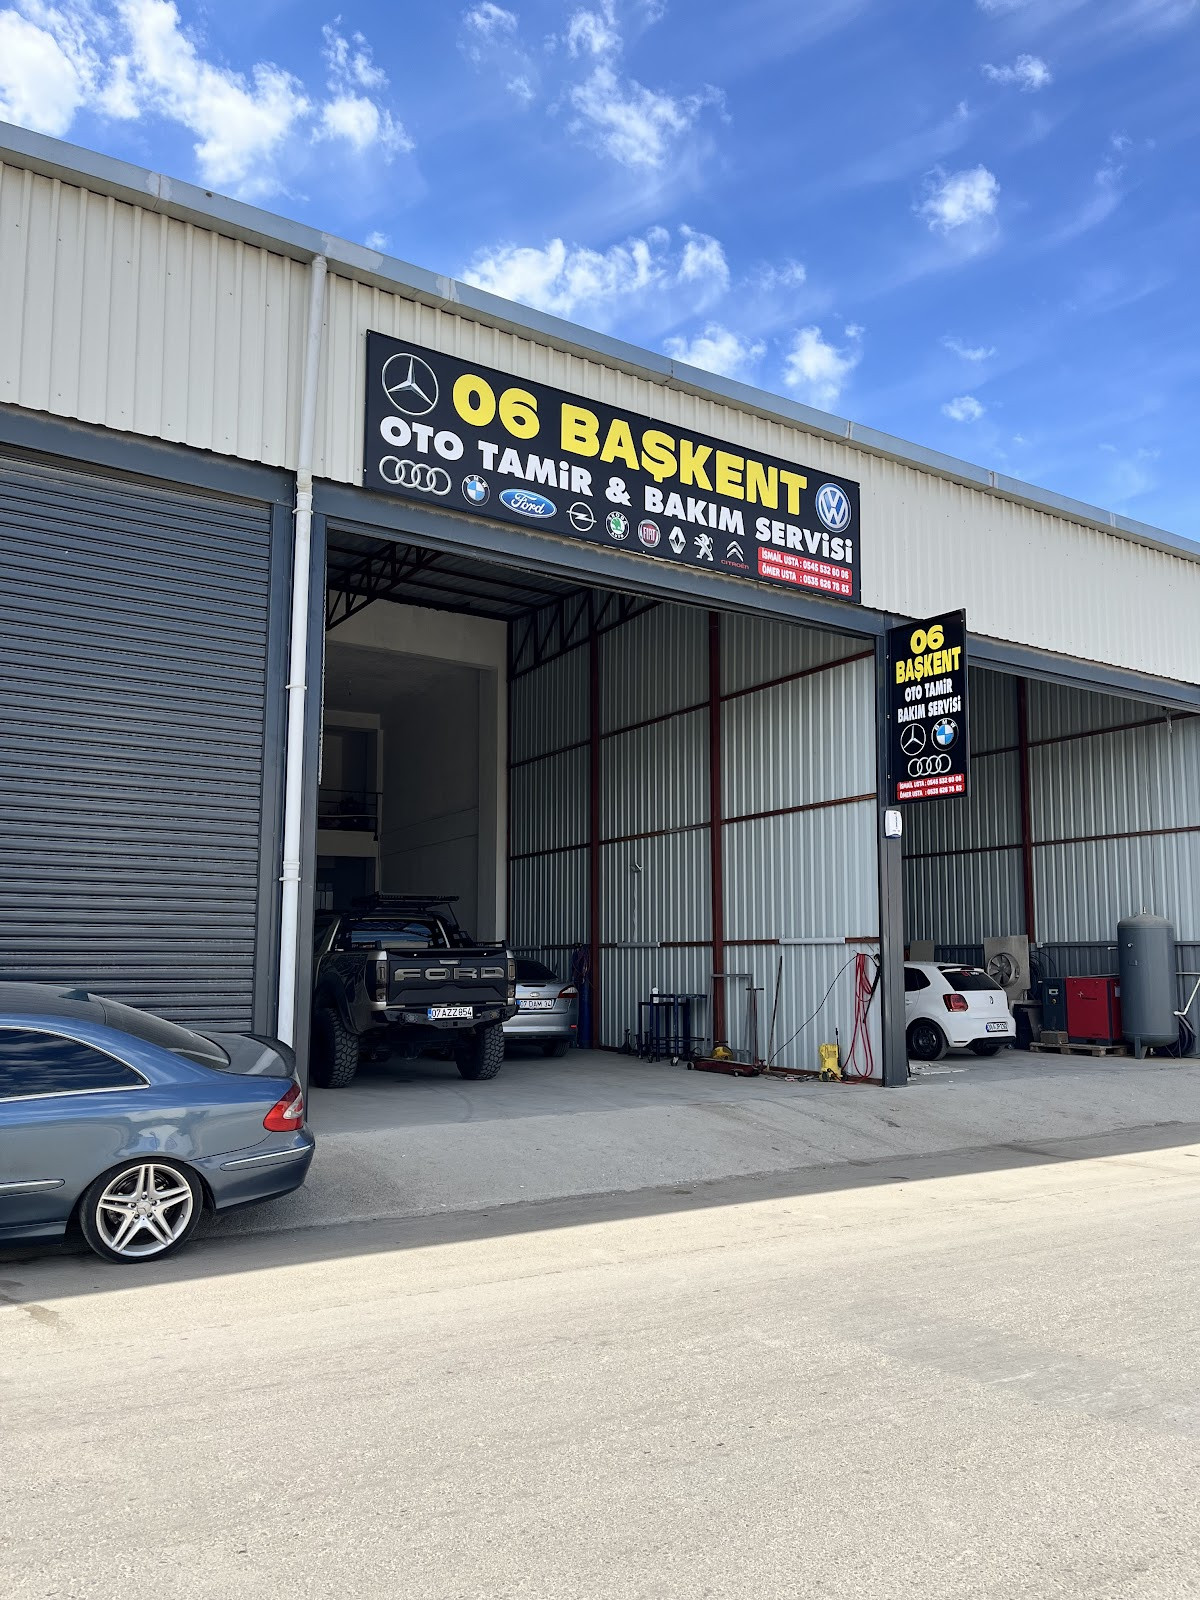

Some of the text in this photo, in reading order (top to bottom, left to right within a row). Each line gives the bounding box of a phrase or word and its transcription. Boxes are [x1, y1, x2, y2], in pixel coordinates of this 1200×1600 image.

[453, 373, 808, 516] 06 BAŞKENT
[380, 415, 464, 461] OTO
[604, 476, 633, 507] &
[644, 484, 746, 537] BAKIM
[511, 492, 546, 514] Ford
[643, 526, 657, 542] FIAT
[761, 562, 781, 576] ÖMER
[781, 569, 797, 581] USTA
[783, 555, 799, 568] USTA
[802, 560, 819, 573] 0545
[910, 624, 945, 655] 06
[895, 646, 962, 684] BAŞKENT
[904, 684, 923, 702] OTO
[897, 703, 926, 724] BAKIM
[394, 967, 504, 981] FORD
